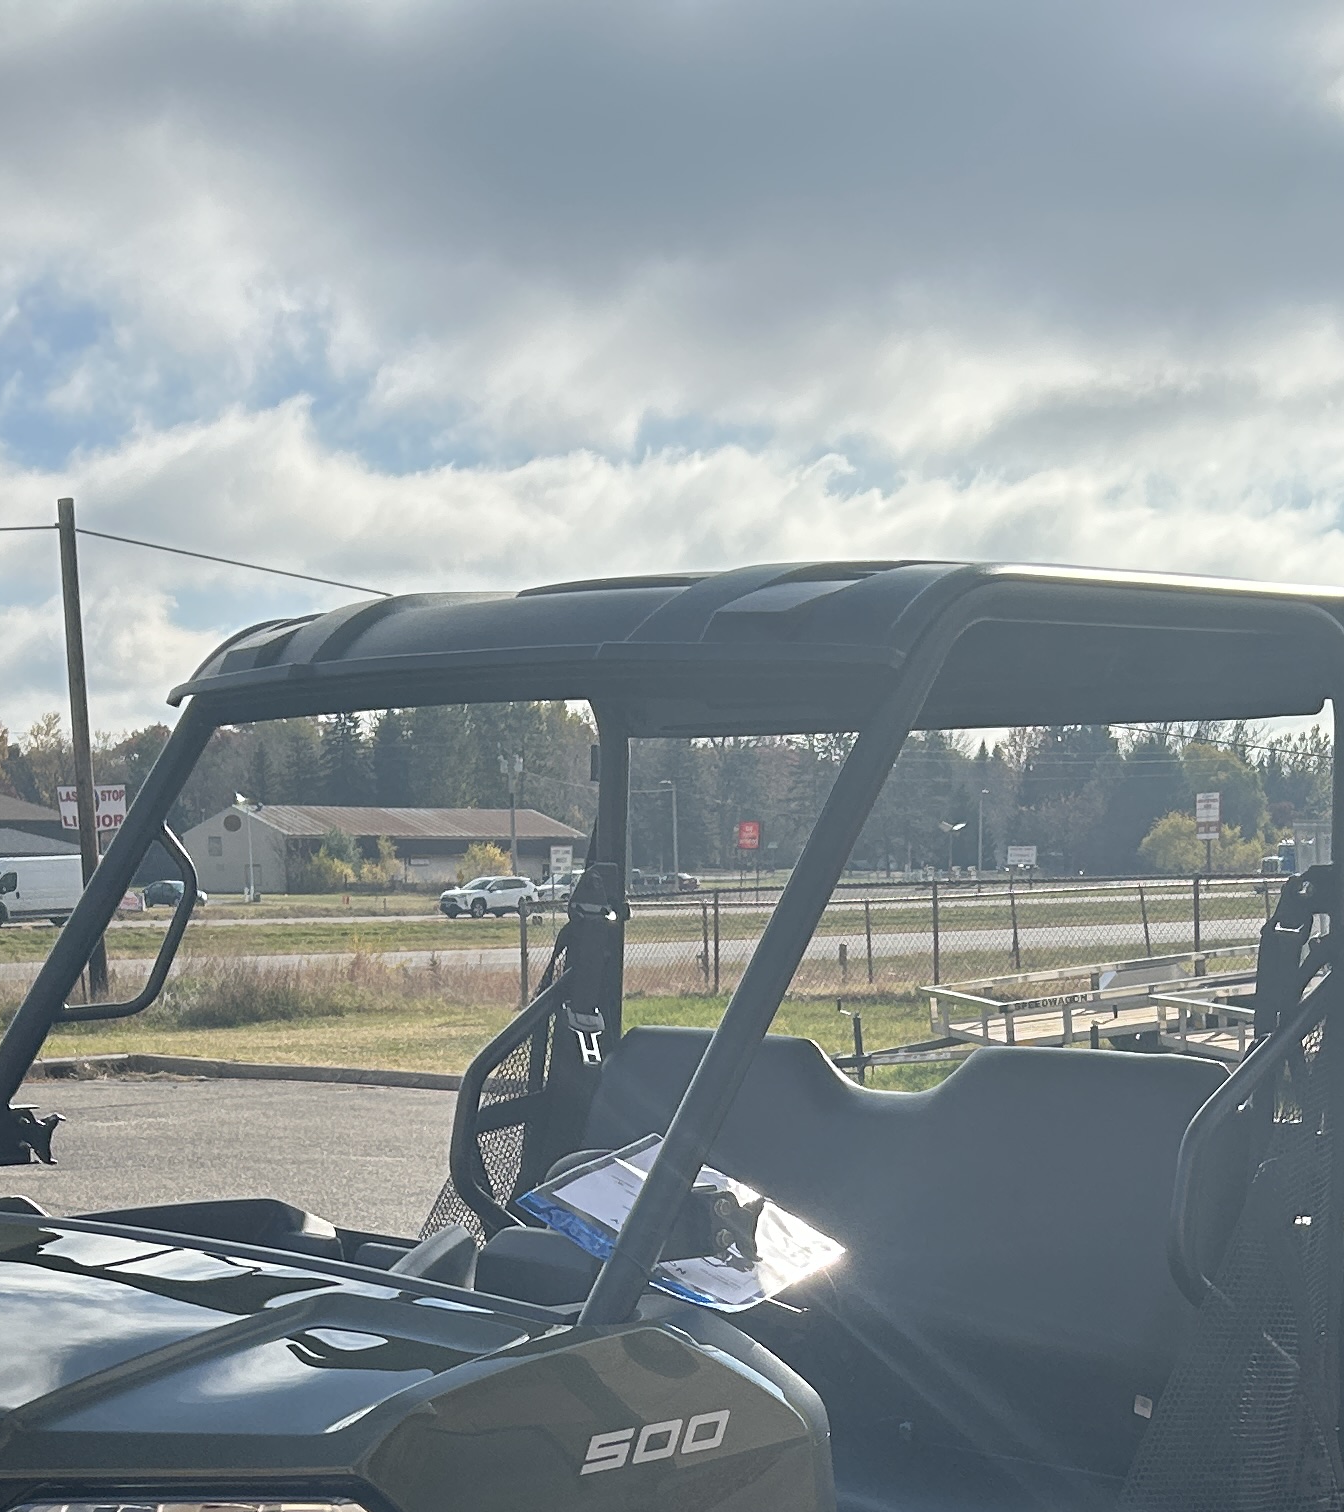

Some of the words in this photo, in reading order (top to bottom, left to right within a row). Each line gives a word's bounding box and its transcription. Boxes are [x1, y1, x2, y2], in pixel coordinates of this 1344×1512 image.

[101, 790, 124, 801] STOP
[63, 814, 124, 828] LIOR
[1015, 994, 1088, 1010] SPEEDWAGON
[580, 1409, 731, 1476] 500
